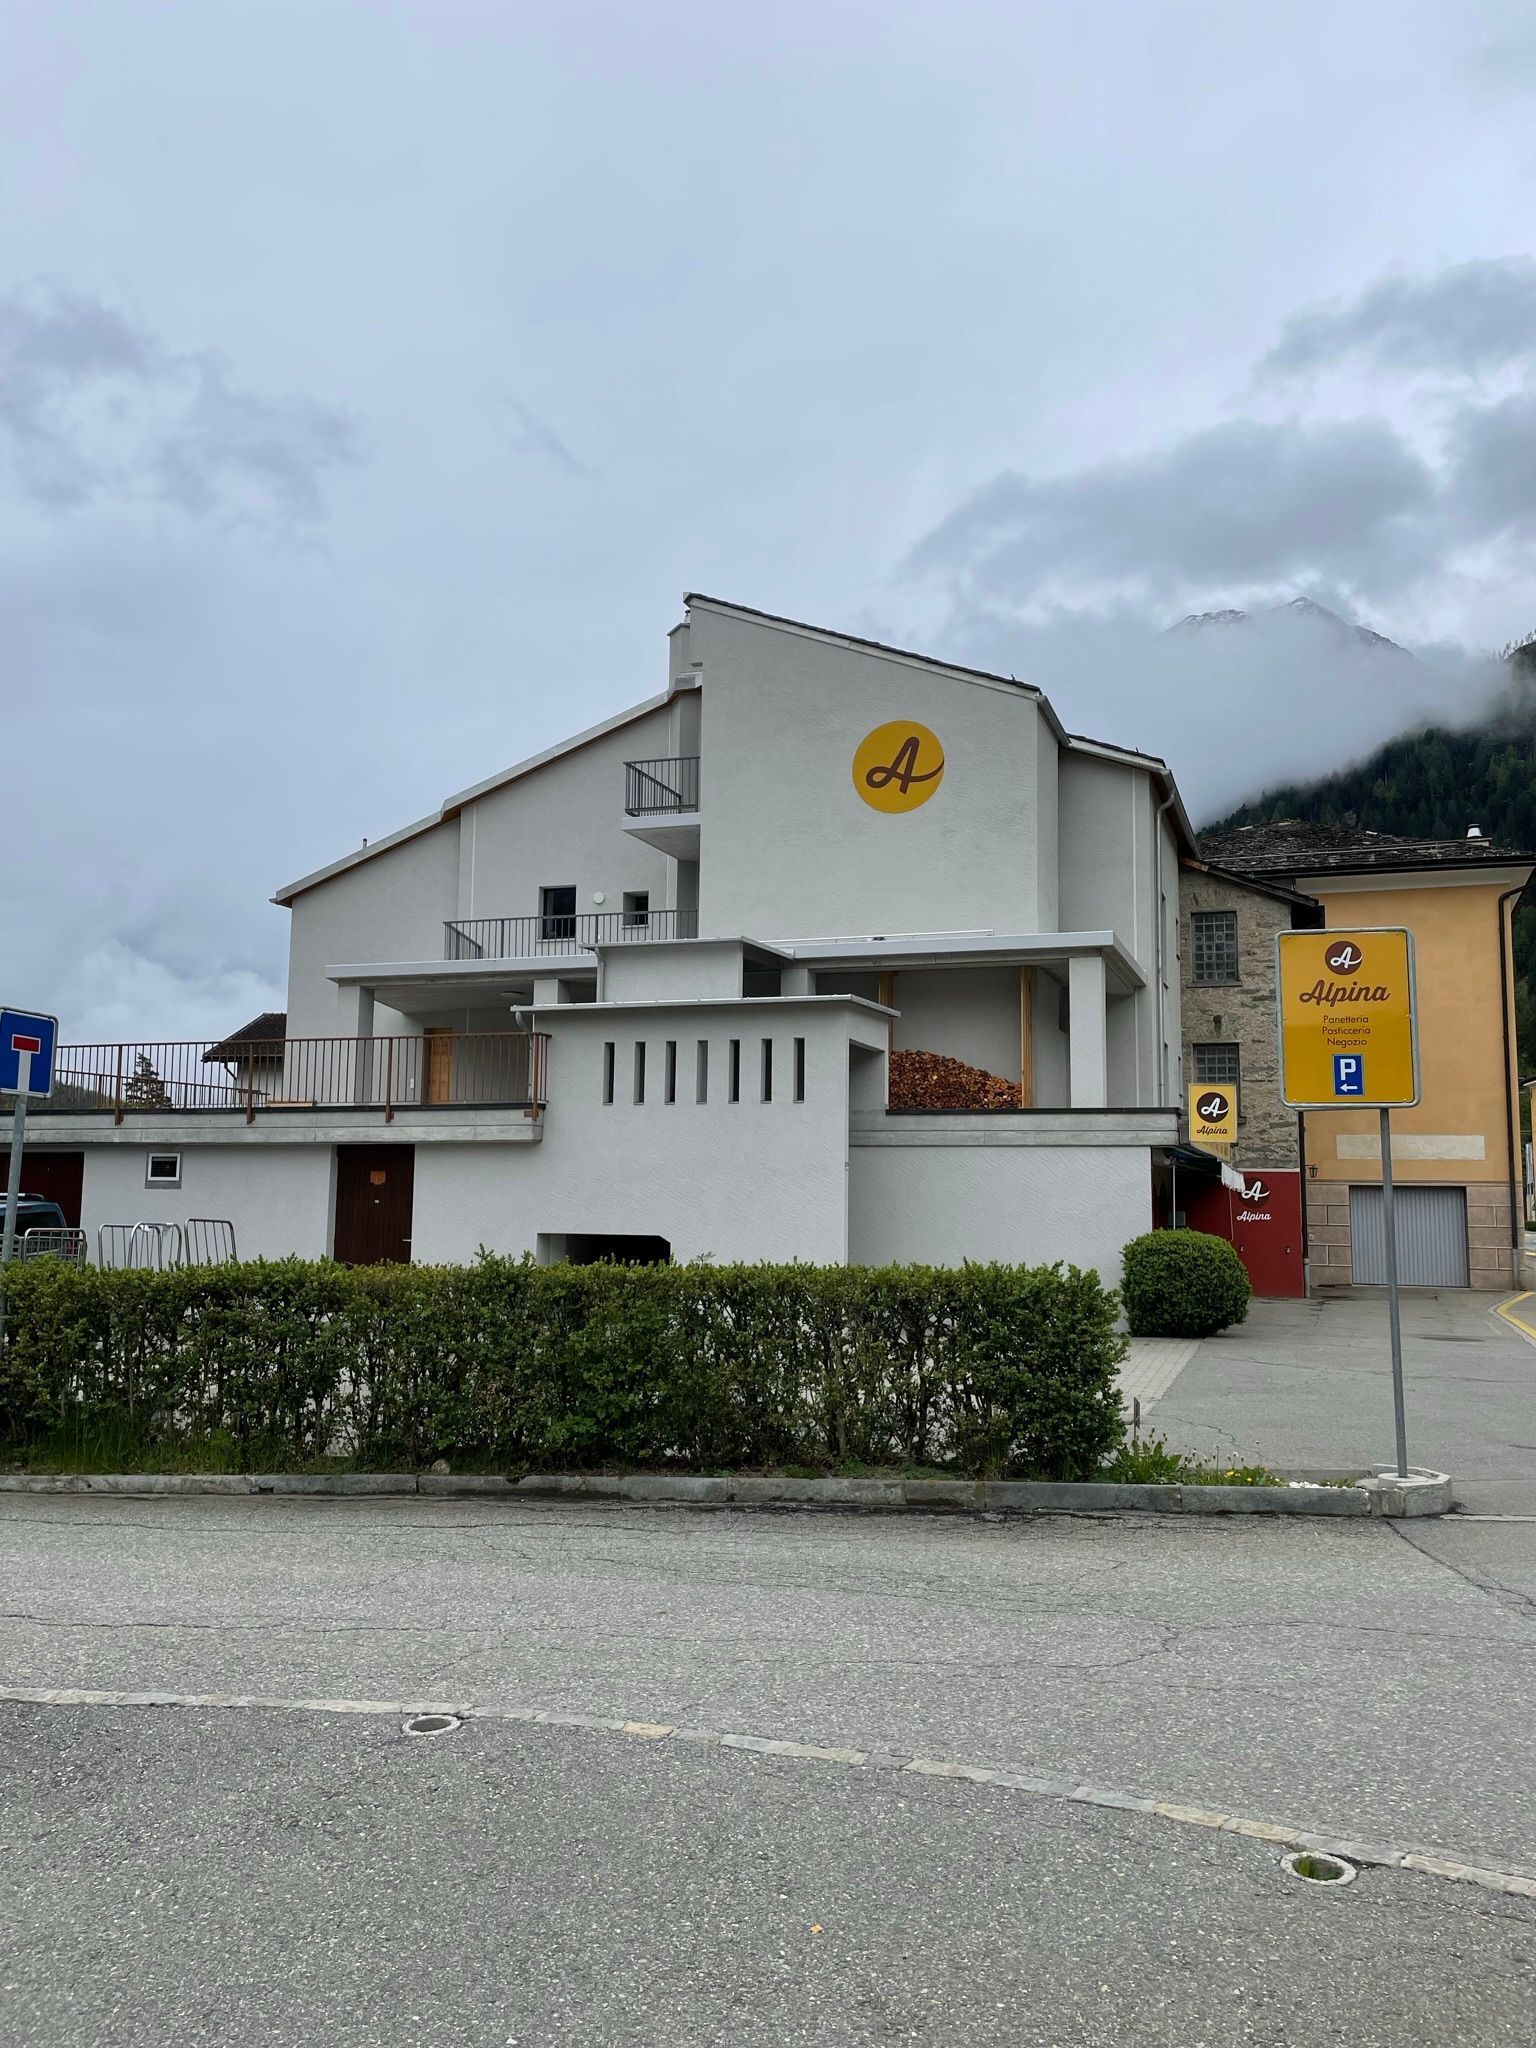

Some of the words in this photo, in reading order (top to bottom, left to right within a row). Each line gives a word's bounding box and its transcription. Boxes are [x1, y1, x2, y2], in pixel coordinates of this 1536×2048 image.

[866, 737, 944, 794] A
[1330, 946, 1362, 969] A
[1299, 980, 1391, 1007] Alpina
[1323, 1015, 1369, 1024] Panetteria
[1322, 1026, 1371, 1035] Pasticceria
[1327, 1038, 1367, 1048] Negozio
[1340, 1058, 1356, 1081] P
[1200, 1097, 1229, 1118] A
[1196, 1125, 1228, 1135] Alpina
[1241, 1181, 1270, 1201] A
[1237, 1211, 1271, 1222] Alpina
